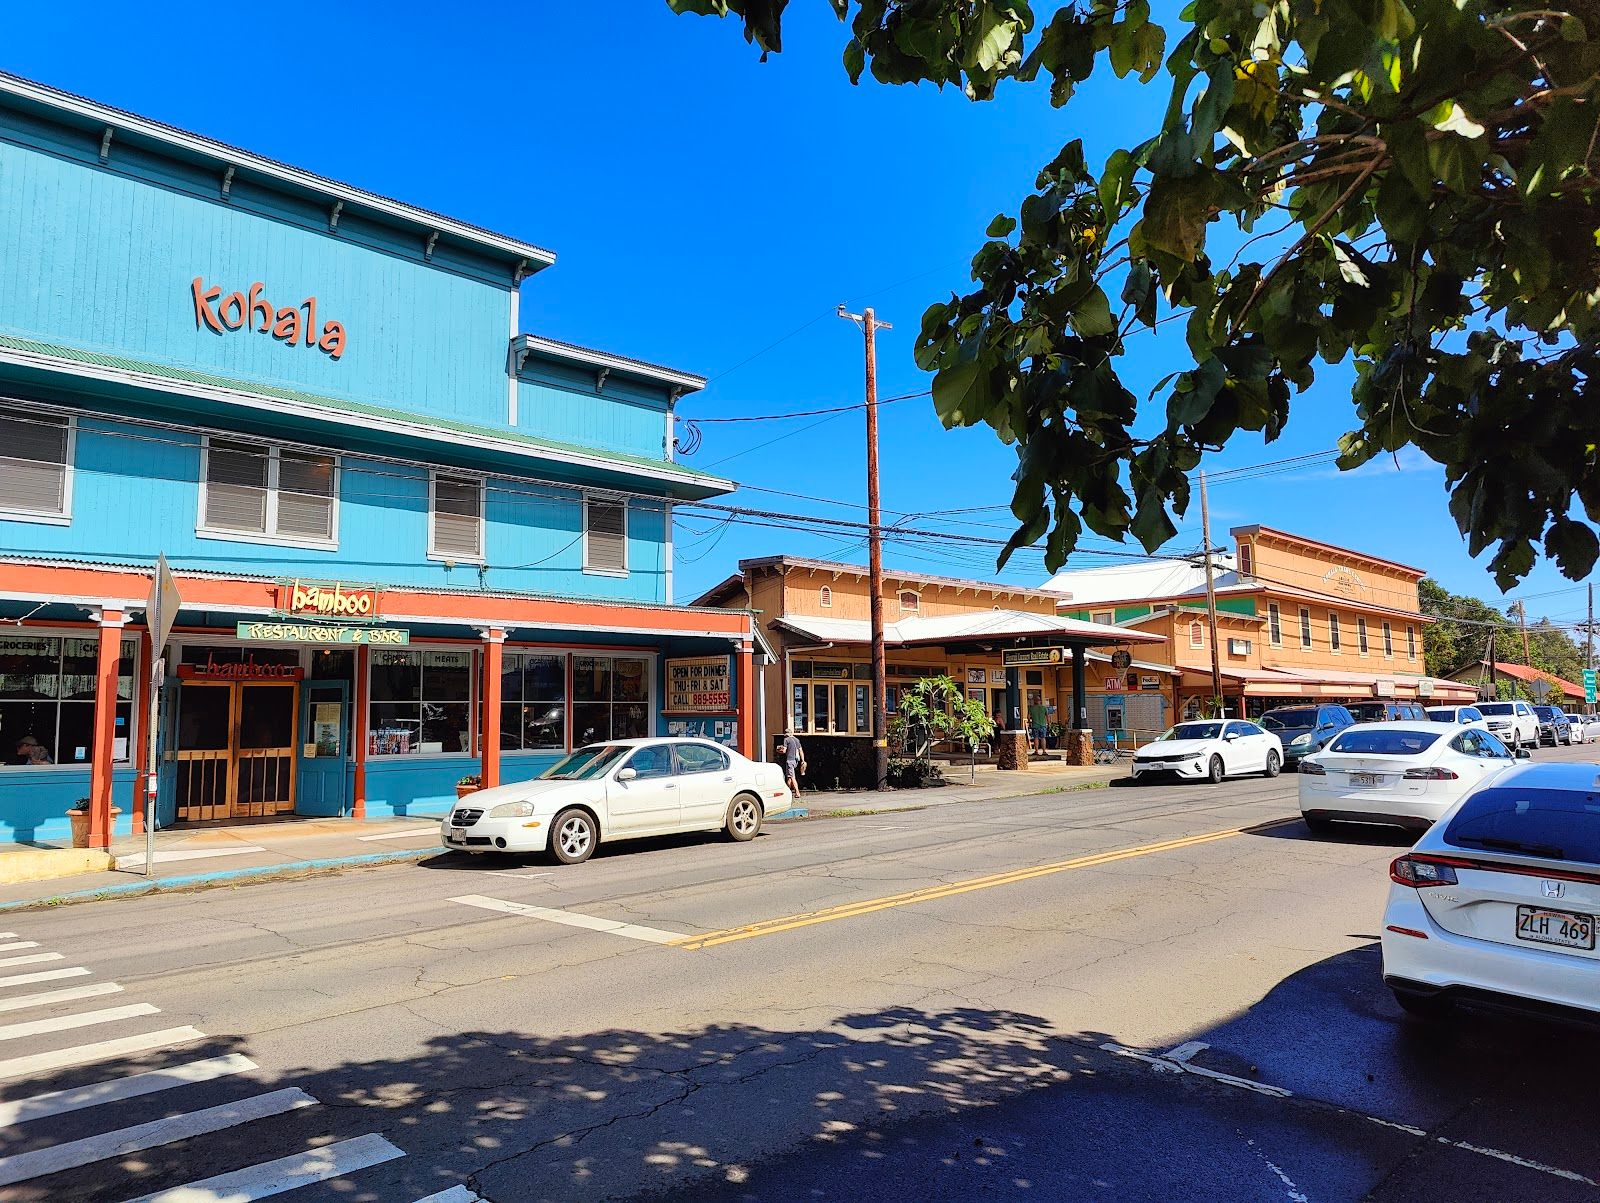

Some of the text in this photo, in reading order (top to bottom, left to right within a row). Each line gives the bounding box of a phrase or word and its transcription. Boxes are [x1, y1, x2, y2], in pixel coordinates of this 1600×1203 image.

[191, 276, 346, 361] Kohala
[290, 578, 371, 614] bamboo
[248, 623, 403, 643] RESTAURANT & BAR
[206, 651, 285, 677] bamboo
[434, 655, 459, 663] MEATS
[673, 665, 726, 678] OPEN FOR DINNER
[702, 681, 708, 690] &
[710, 679, 723, 690] SAT
[1106, 678, 1121, 690] ATM
[673, 695, 688, 705] CALL
[1520, 913, 1550, 935] ZLH
[1559, 920, 1589, 940] 469
